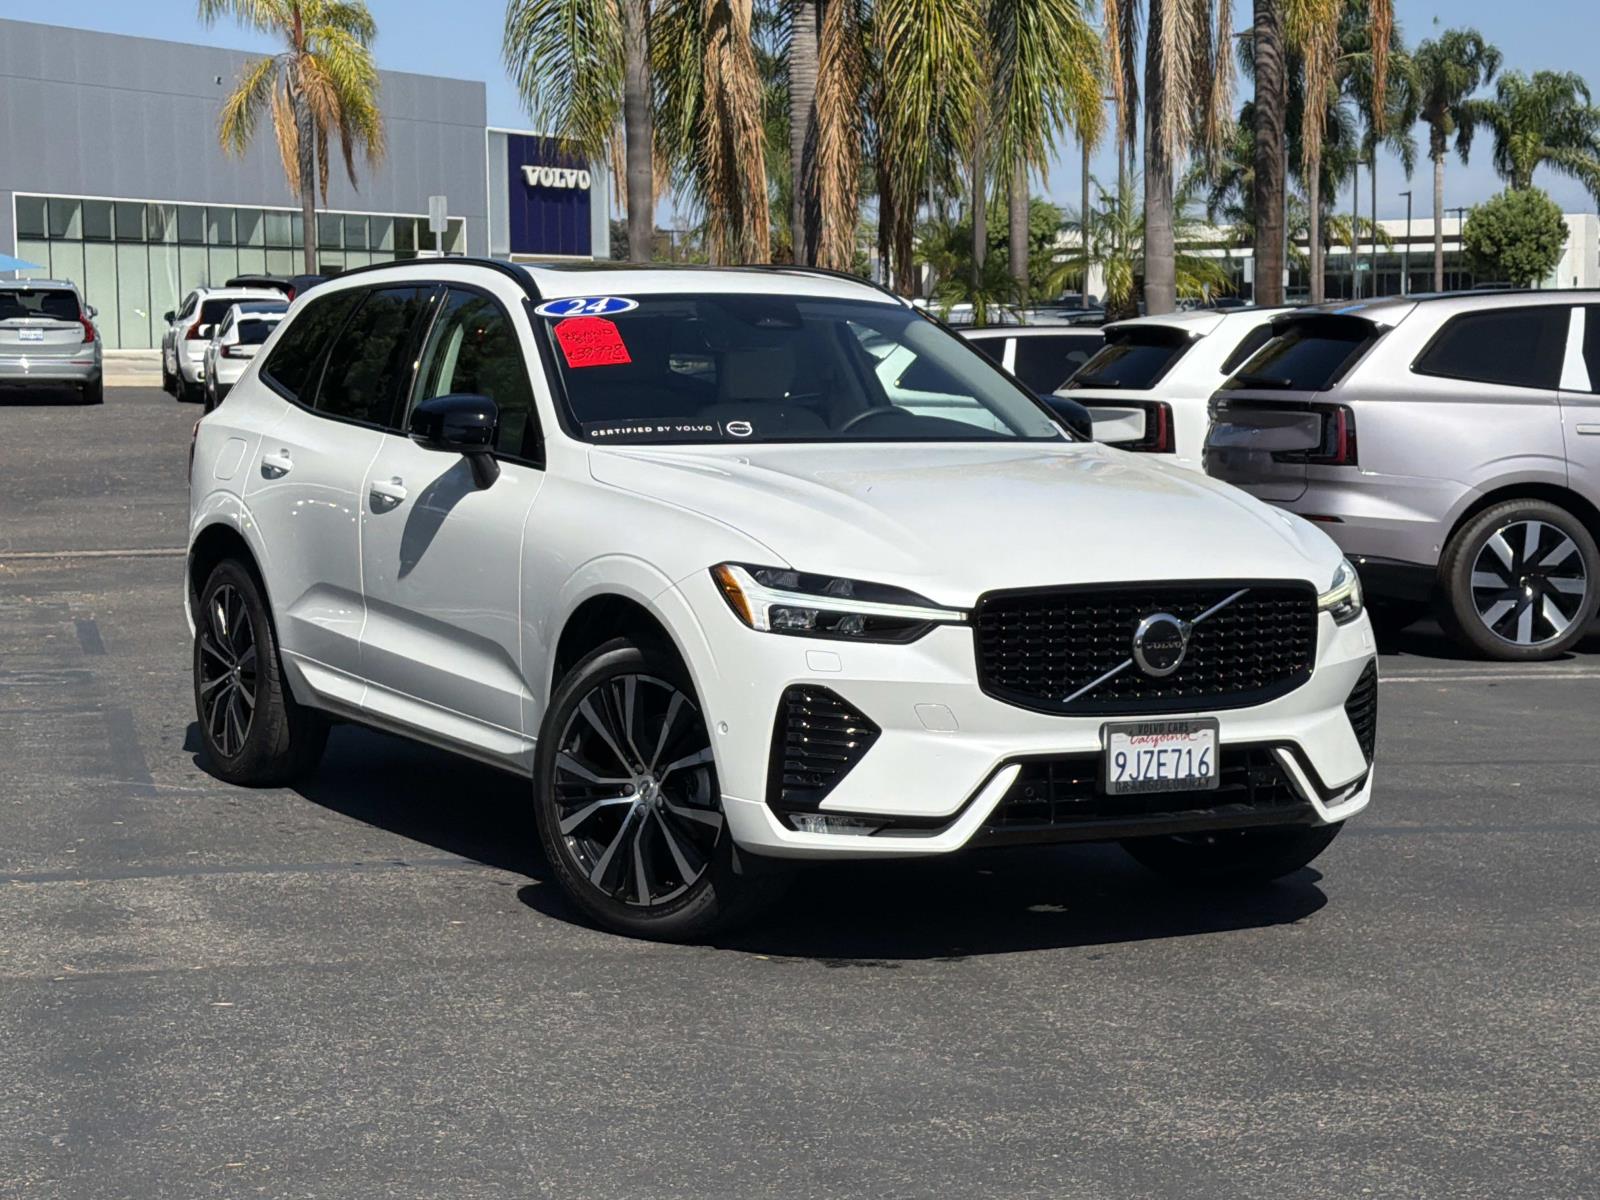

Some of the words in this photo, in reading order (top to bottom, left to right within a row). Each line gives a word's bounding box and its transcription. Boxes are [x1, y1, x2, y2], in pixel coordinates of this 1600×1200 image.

[521, 165, 591, 190] VOLVO
[563, 297, 611, 315] 24
[591, 426, 652, 437] CERTIFIED
[1138, 723, 1165, 735] VOLVO
[1115, 747, 1210, 782] 9JZE716
